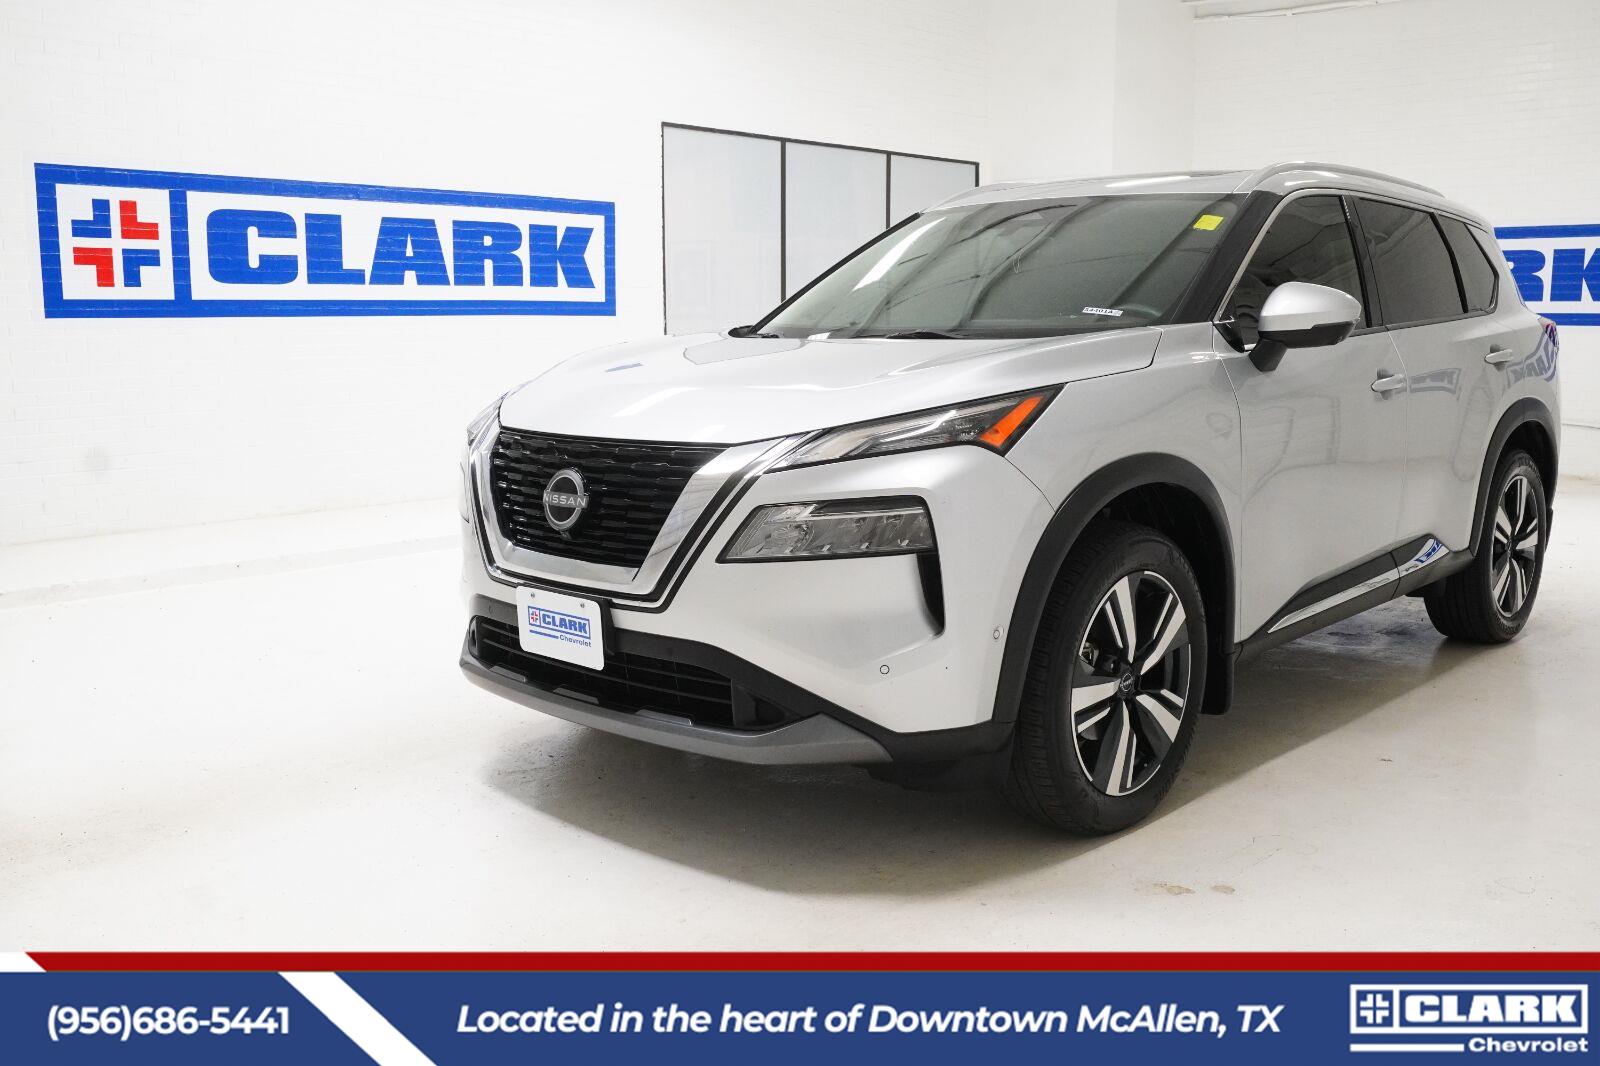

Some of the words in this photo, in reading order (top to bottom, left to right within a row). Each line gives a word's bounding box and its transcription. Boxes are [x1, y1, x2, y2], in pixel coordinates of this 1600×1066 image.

[206, 208, 595, 288] CLARK
[544, 493, 586, 506] NISSAN
[541, 613, 588, 634] CLARK
[559, 634, 592, 647] Chevrolet
